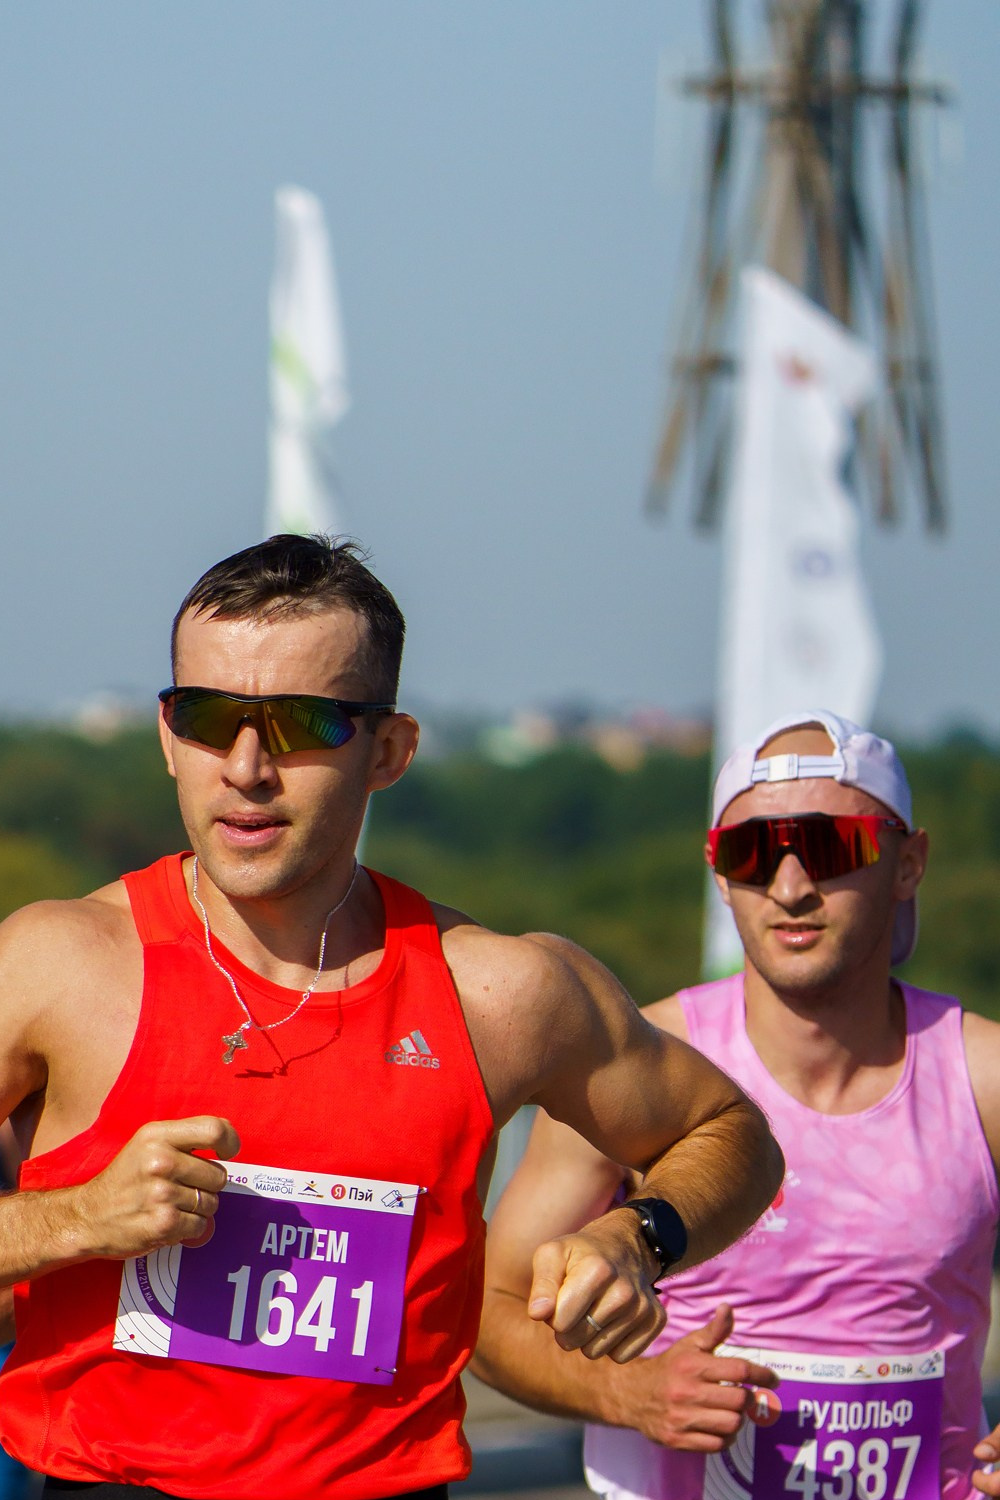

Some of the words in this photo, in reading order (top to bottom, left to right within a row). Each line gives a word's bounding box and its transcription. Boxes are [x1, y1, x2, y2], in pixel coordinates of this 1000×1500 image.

[384, 1051, 440, 1069] adidas
[235, 1176, 248, 1184] 40
[255, 1182, 293, 1195] МАРАФОН
[348, 1186, 374, 1202] Пэй
[260, 1222, 349, 1264] АРТЕМ
[227, 1265, 374, 1357] 1641
[892, 1363, 913, 1375] Пэй
[798, 1399, 913, 1433] РУДОЛЬФ
